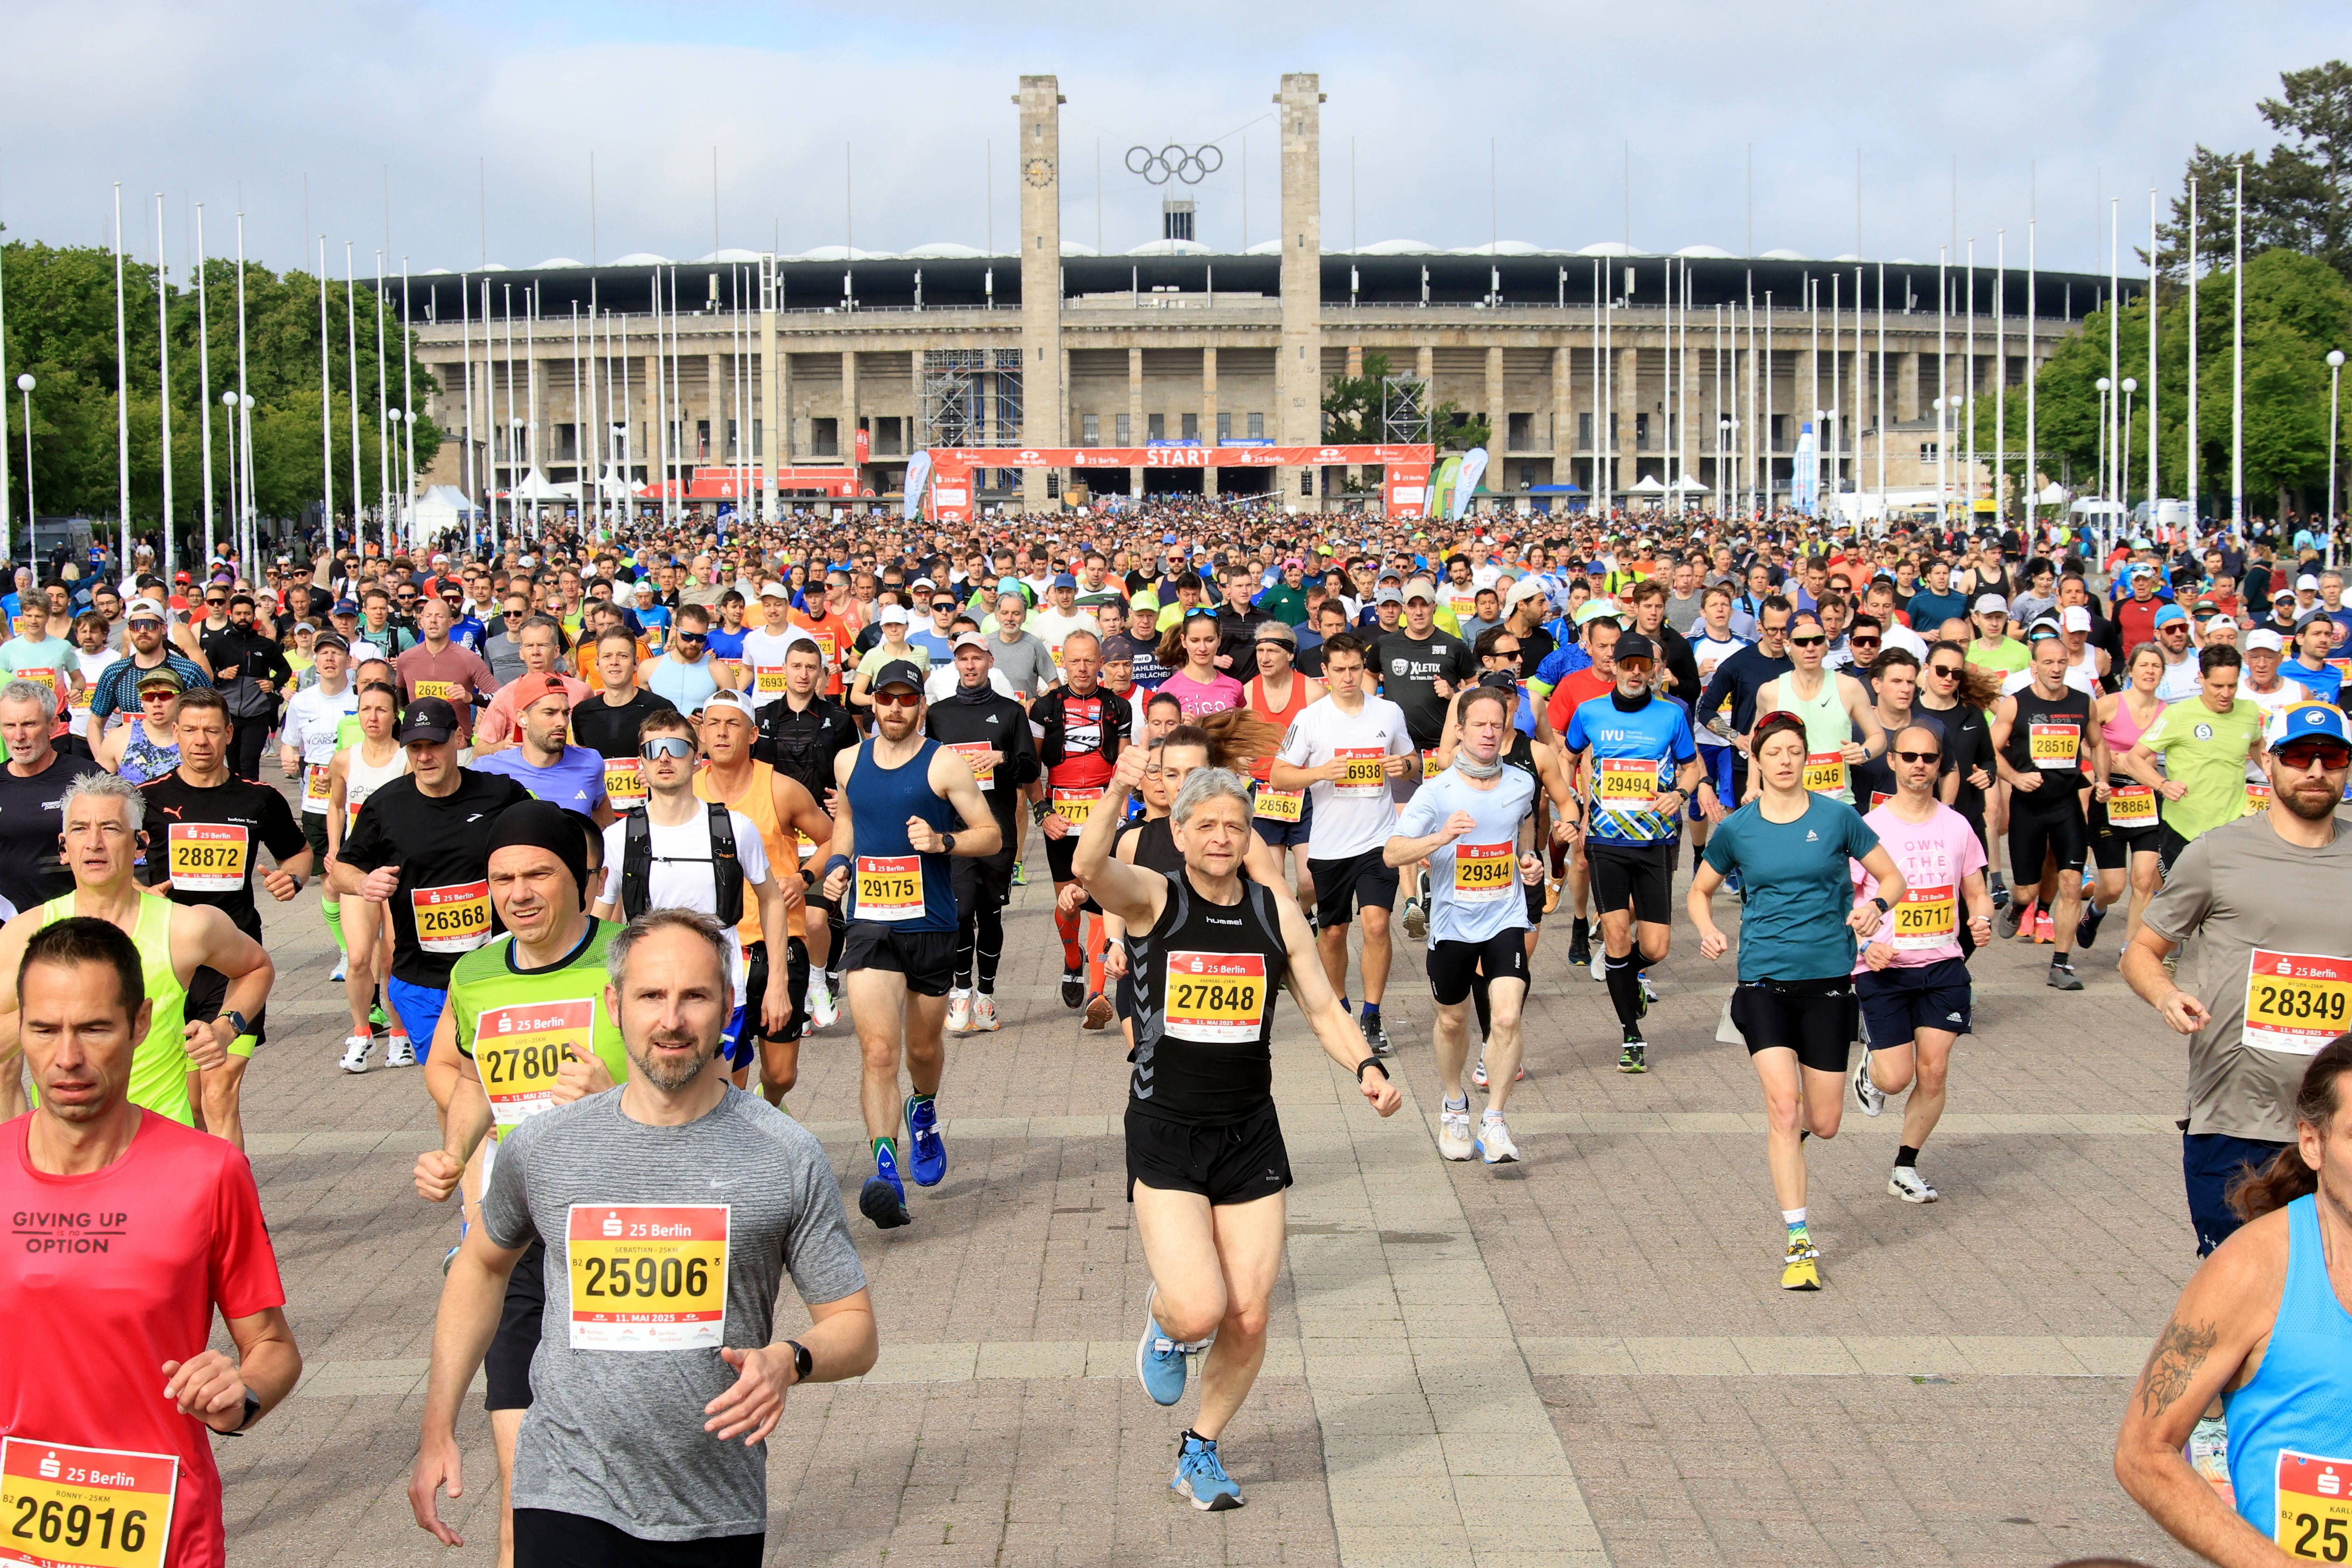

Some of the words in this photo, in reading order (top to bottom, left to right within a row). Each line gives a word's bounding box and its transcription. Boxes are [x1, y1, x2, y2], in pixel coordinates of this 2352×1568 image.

[1147, 449, 1212, 465] START
[907, 670, 918, 679] RUN
[1410, 661, 1440, 675] XLETIX
[1601, 730, 1624, 741] IVU
[2036, 741, 2073, 752] 28516
[1344, 764, 1380, 778] 6938
[1803, 769, 1839, 785] 7946
[606, 776, 641, 791] 6219
[1608, 777, 1650, 792] 29494
[1059, 805, 1093, 819] 2771
[1260, 799, 1296, 814] 28563
[2113, 800, 2150, 813] 28864
[1904, 840, 1944, 852] OWN
[179, 847, 239, 867] 28872
[1907, 855, 1945, 868] THE
[1462, 861, 1509, 881] 29344
[1908, 873, 1946, 885] CITY
[864, 879, 914, 897] 29175
[454, 892, 474, 901] Berlin
[424, 905, 485, 931] 26368
[1206, 916, 1243, 926] hummel
[1902, 906, 1950, 927] 26717
[1208, 965, 1218, 973] 25
[1221, 965, 1245, 974] Berlin
[2295, 967, 2307, 976] 25
[2310, 969, 2337, 979] Berlin
[1177, 984, 1254, 1011] 27848
[2259, 986, 2345, 1020] 28349
[517, 1021, 531, 1031] 25
[534, 1017, 564, 1030] Berlin
[13, 1211, 91, 1228] GIVING
[99, 1212, 128, 1227] UP
[56, 1228, 66, 1237] is
[629, 1224, 646, 1236] 25
[651, 1224, 691, 1237] Berlin
[25, 1239, 109, 1253] OPTION
[585, 1257, 708, 1297] 25906
[615, 1314, 629, 1322] 11.
[652, 1314, 675, 1322] 2025
[66, 1468, 86, 1482] 25
[90, 1470, 135, 1487] Berlin
[3, 1494, 14, 1503] B2
[56, 1490, 81, 1499] RONNY
[89, 1494, 111, 1503] 25KM
[2282, 1511, 2293, 1520] B2
[12, 1496, 147, 1553] 26916
[2295, 1513, 2348, 1563] 25
